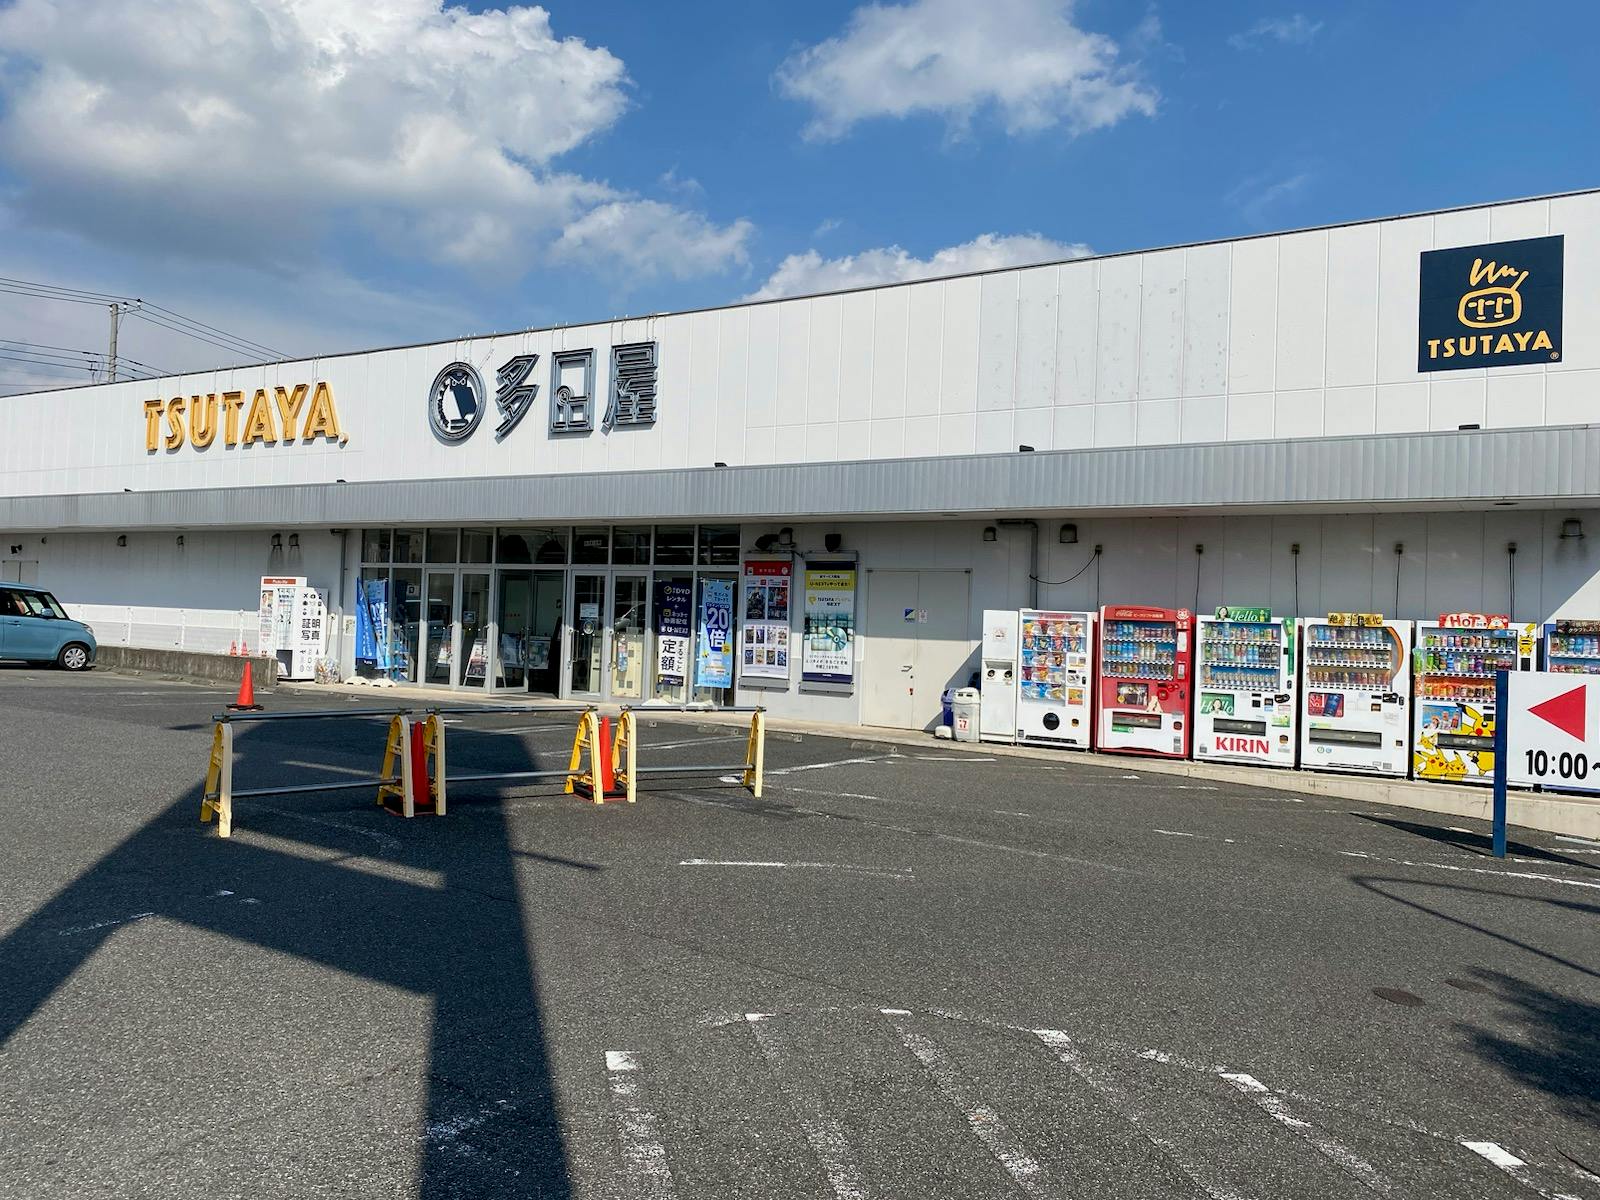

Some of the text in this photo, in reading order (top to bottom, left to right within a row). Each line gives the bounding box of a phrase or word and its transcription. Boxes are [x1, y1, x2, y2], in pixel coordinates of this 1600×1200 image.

[1427, 330, 1553, 359] TSUTAYA
[144, 381, 342, 451] TSUTAYA
[302, 618, 321, 629] 証明
[707, 608, 729, 630] 20
[301, 630, 320, 641] 写真
[709, 629, 726, 647] 倍
[661, 639, 677, 671] 定額
[675, 640, 684, 673] まるごと
[1216, 736, 1270, 754] KIRIN
